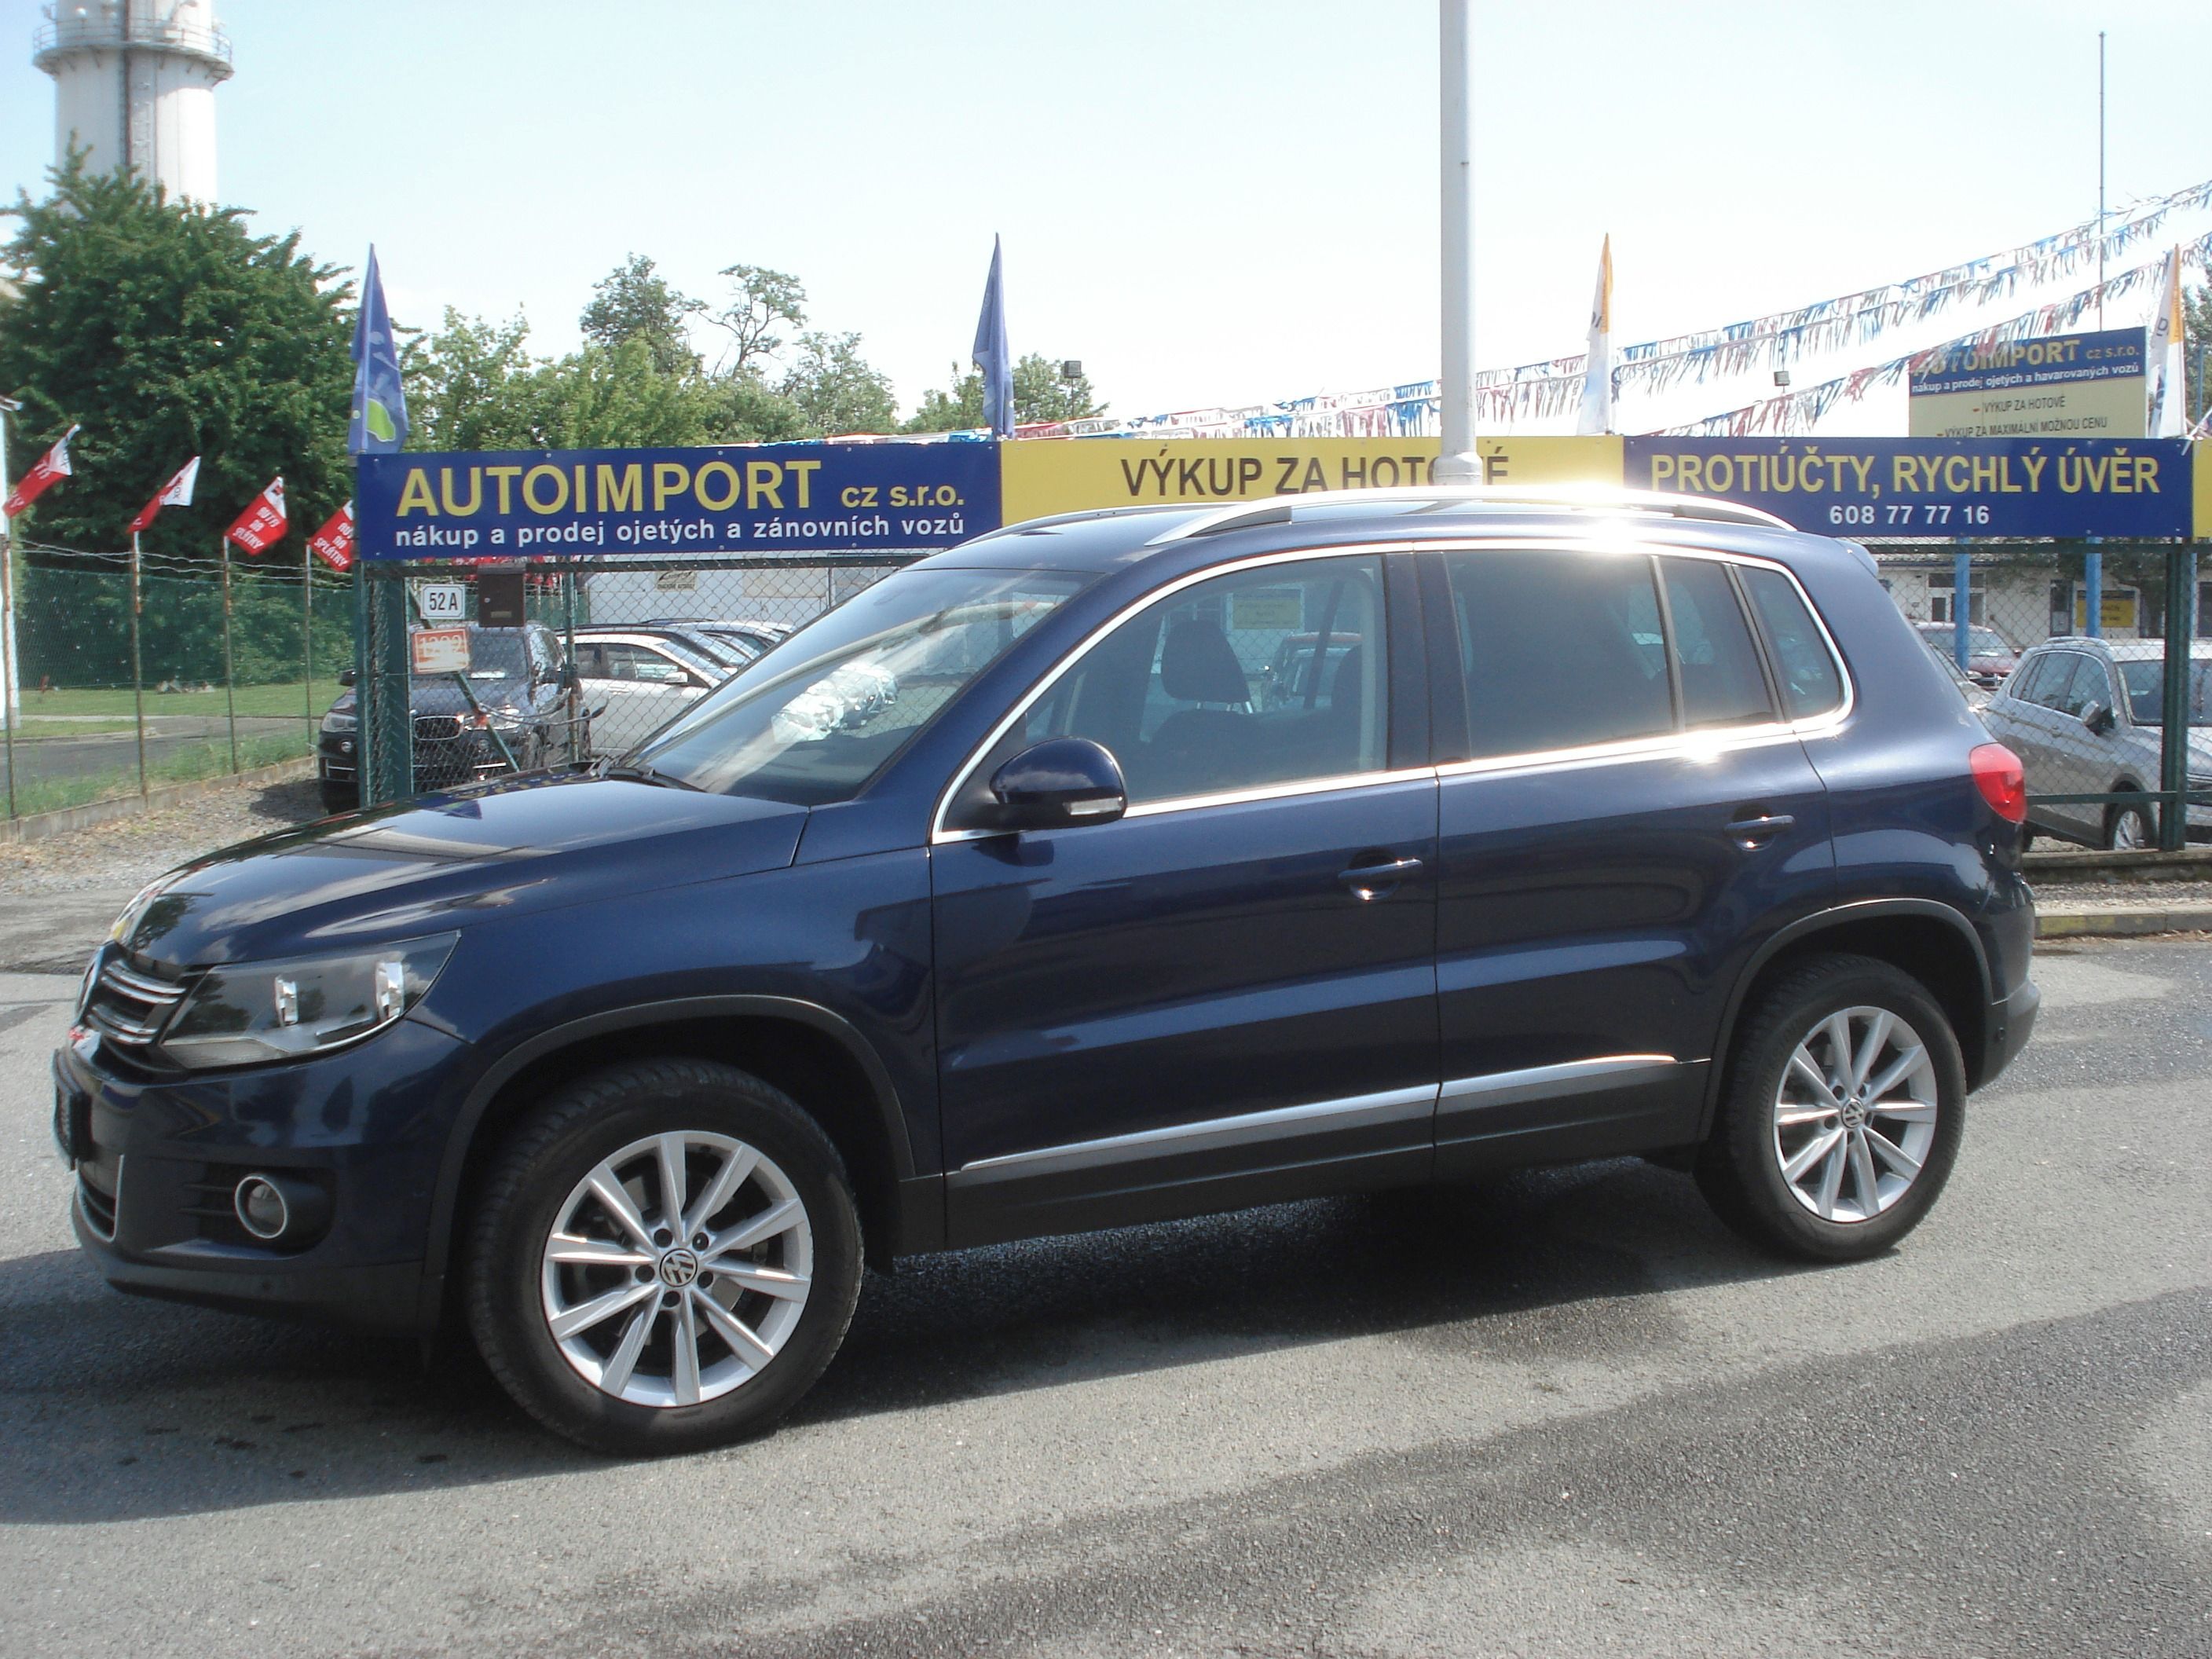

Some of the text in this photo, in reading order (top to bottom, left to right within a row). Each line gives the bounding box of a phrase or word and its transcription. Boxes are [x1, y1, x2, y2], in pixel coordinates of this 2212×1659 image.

[1952, 377, 1983, 391] prodej
[1986, 374, 2023, 388] ojetých
[2034, 366, 2109, 381] havarovaných
[396, 460, 965, 518] AUTOIMPORT cz s.r.o.
[1121, 446, 1509, 496] VÝKUP ZA HOTÉ
[1651, 445, 2160, 500] PROTIÚČTY, RYCHLÝ ÚVĚR
[395, 512, 965, 549] nákup a prodej ojetých a zánovních vozů
[1829, 505, 1990, 526] 608 77 77 16
